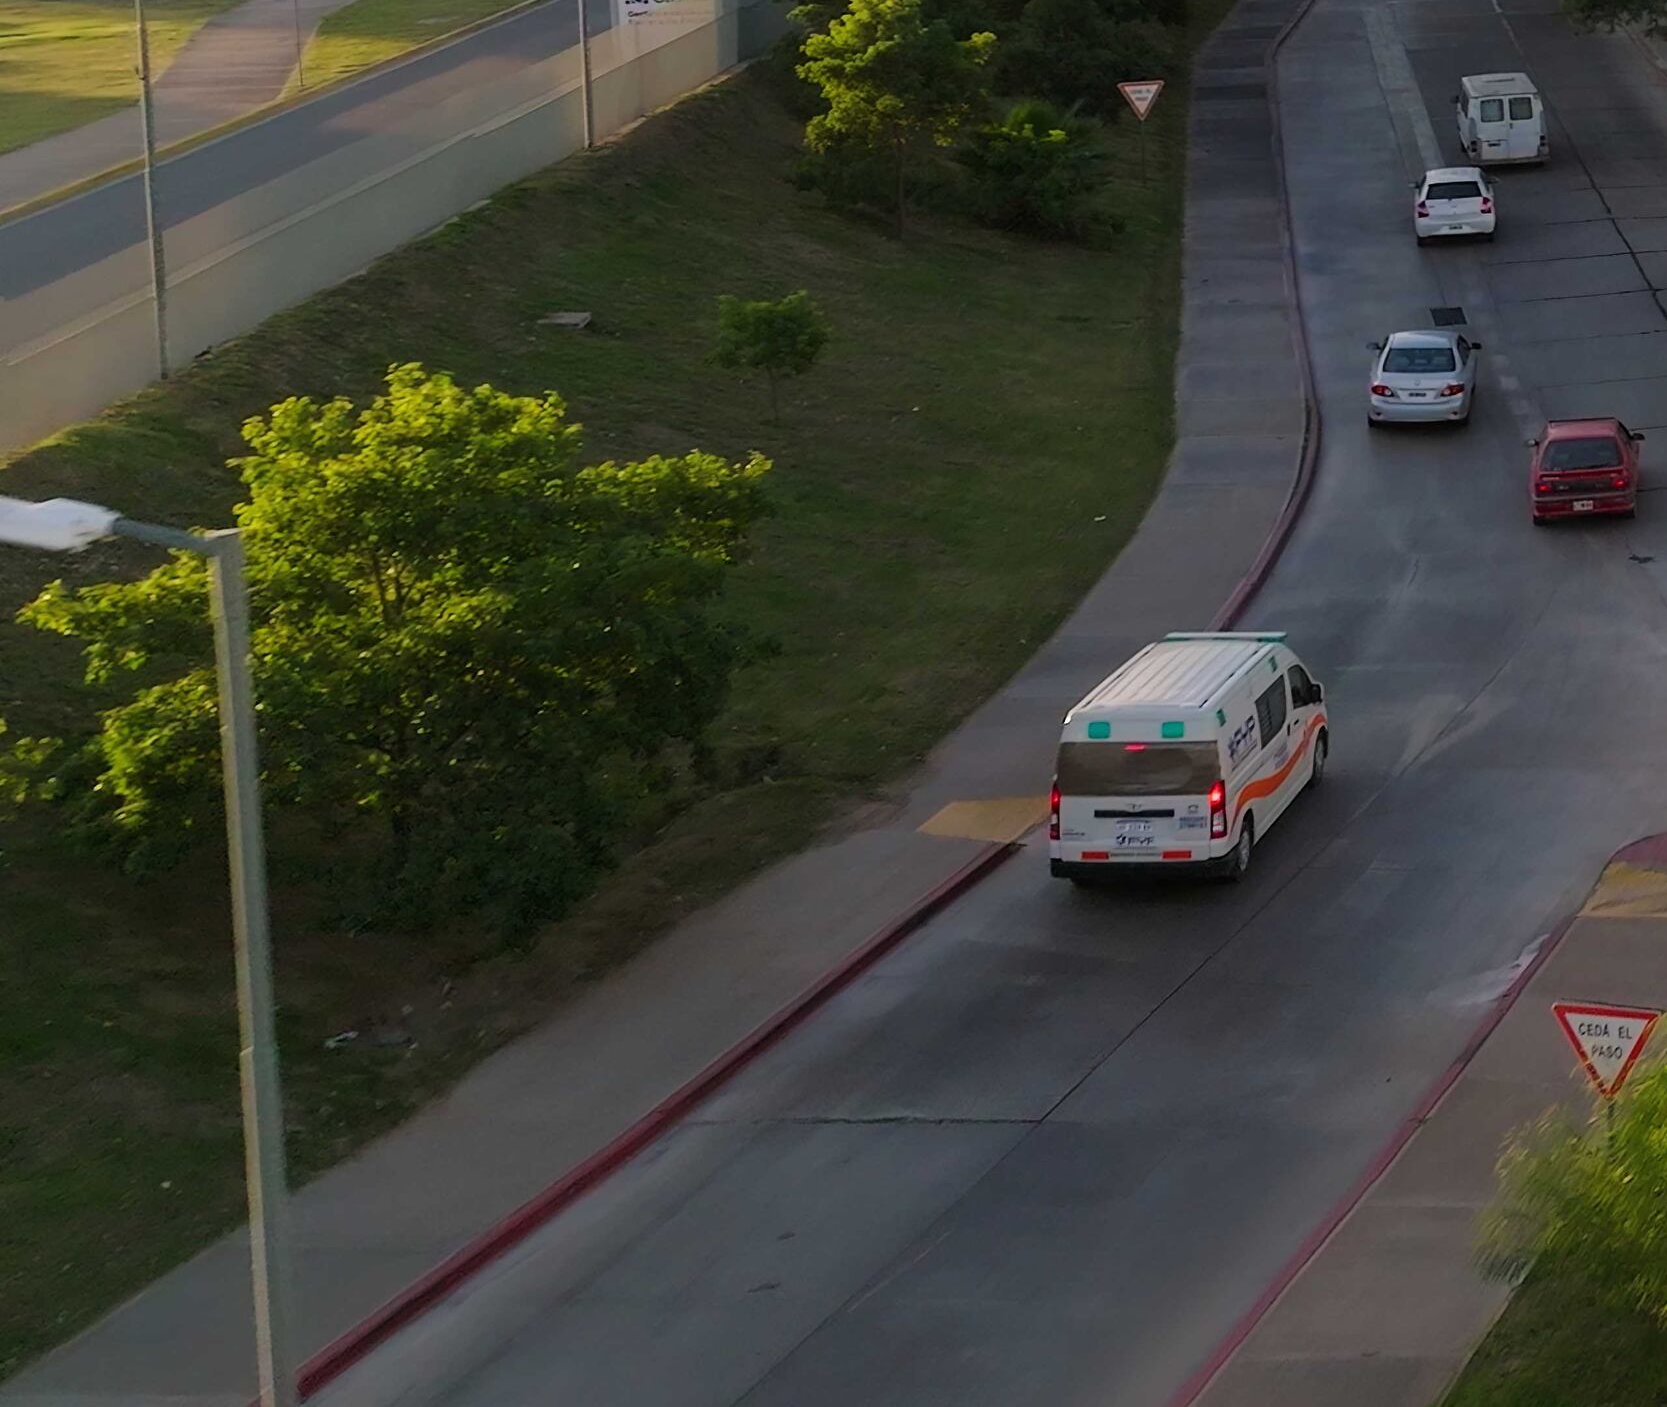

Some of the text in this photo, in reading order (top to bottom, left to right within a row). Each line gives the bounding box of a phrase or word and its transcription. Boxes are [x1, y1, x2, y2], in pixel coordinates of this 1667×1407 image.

[1578, 1022, 1633, 1040] CEDA EL
[1591, 1044, 1623, 1060] PASO
